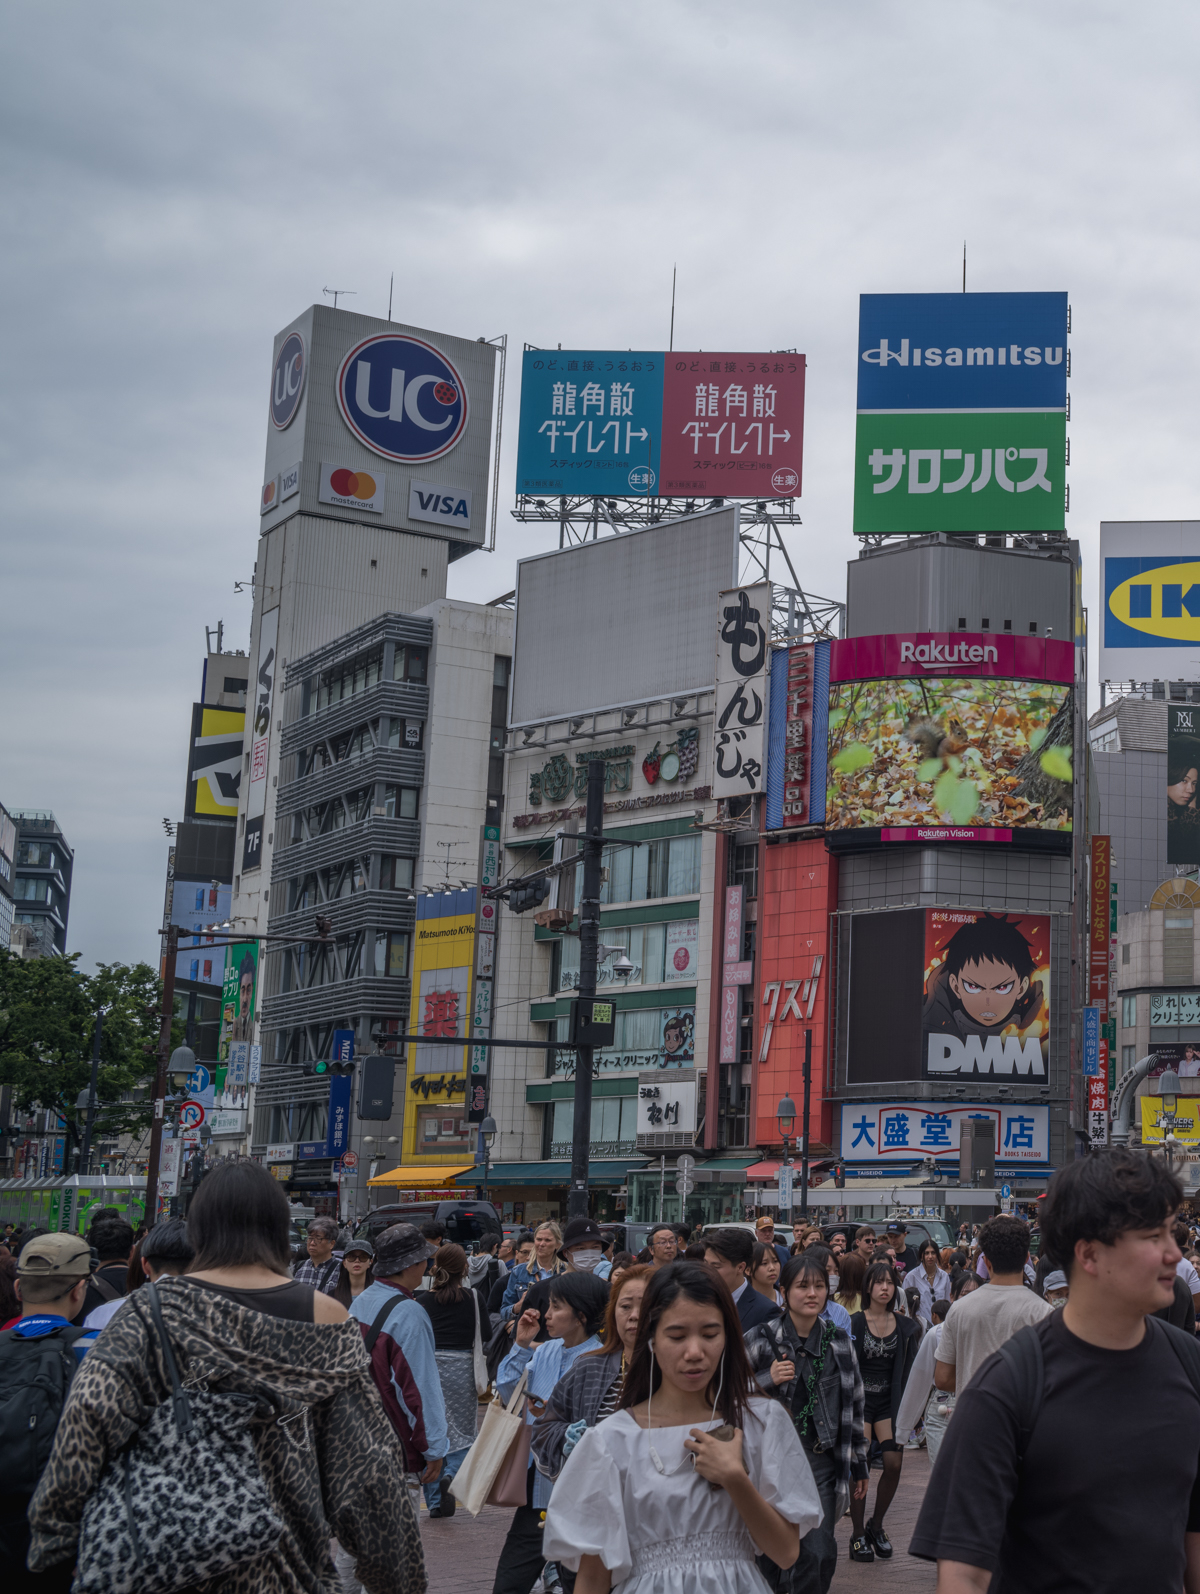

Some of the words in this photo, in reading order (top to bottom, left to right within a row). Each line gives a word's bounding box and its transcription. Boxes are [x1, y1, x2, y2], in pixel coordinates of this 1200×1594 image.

[533, 359, 656, 374] のど、直接、うるおう
[675, 361, 798, 375] のど、直接、うるおう
[862, 339, 1063, 367] Hisamitsu
[355, 359, 454, 432] UC
[552, 381, 635, 418] 龍角散
[695, 383, 777, 419] 龍角散
[538, 420, 649, 454] ダイレクト
[681, 422, 792, 456] ダイレクト
[550, 459, 593, 469] スティック
[630, 474, 654, 485] 生薬
[693, 460, 736, 471] スティック
[868, 447, 1053, 495] サロンパス
[282, 471, 297, 491] VISA
[773, 475, 797, 487] 生薬
[331, 496, 373, 509] mastercard
[413, 489, 469, 518] VISA
[900, 640, 998, 664] Rakuten
[716, 591, 767, 790] もんじゃ
[783, 650, 809, 818] 三千里薬品
[247, 831, 261, 854] 7F
[917, 830, 949, 839] Rakuten
[950, 830, 975, 838] Vision
[1093, 840, 1108, 943] クスリのことなら
[418, 928, 457, 941] Matsumoto
[726, 889, 742, 959] お好み焼
[1091, 951, 1108, 1014] 三千里
[424, 990, 460, 1038] 薬
[928, 1033, 1046, 1076] DMM
[1085, 1010, 1097, 1074] 大盛堂商事ビル
[234, 1044, 247, 1083] 渋谷駅前
[639, 1087, 661, 1099] うなぎ
[333, 1106, 345, 1148] みずほ銀行
[851, 1113, 1036, 1149] 大盛堂店
[1091, 1112, 1107, 1140] 牛繁
[1021, 1151, 1042, 1159] TAISEIDO
